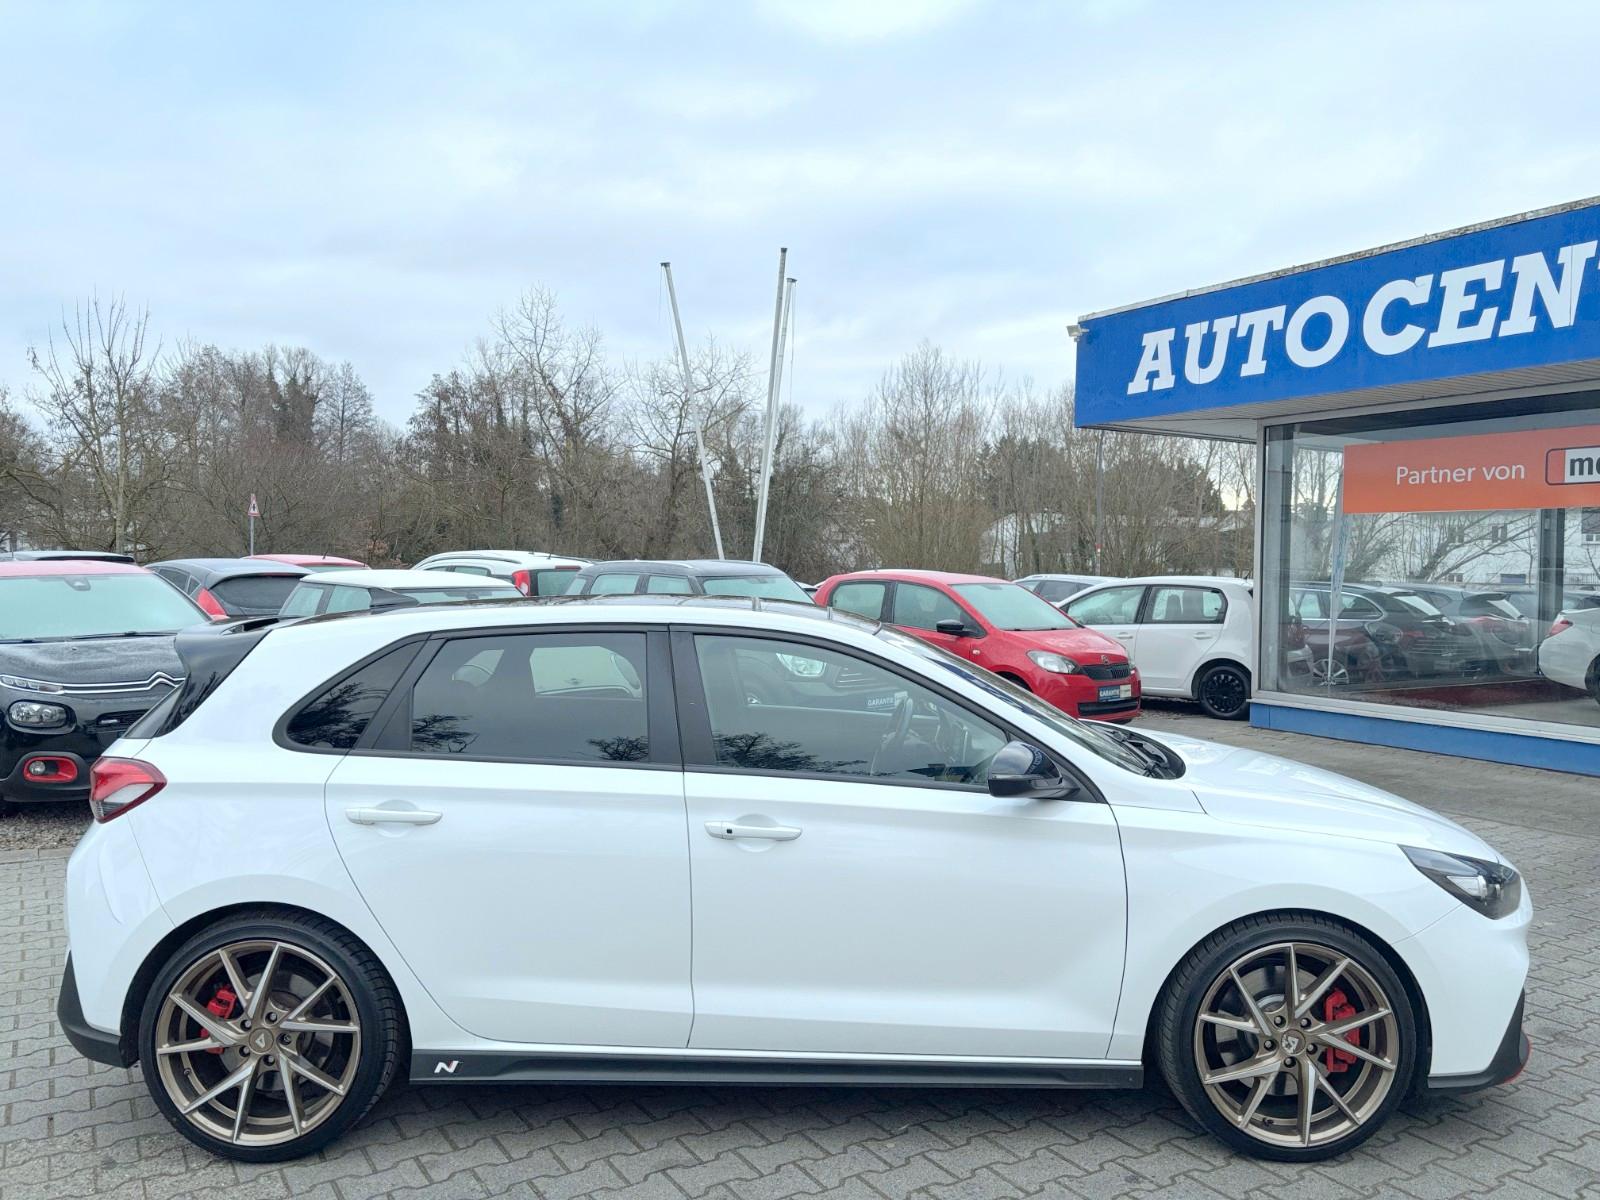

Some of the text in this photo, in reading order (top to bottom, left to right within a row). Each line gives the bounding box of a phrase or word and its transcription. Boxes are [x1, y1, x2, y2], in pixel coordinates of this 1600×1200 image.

[1396, 465, 1476, 484] Partner
[1482, 463, 1525, 480] von
[434, 1060, 459, 1073] N
